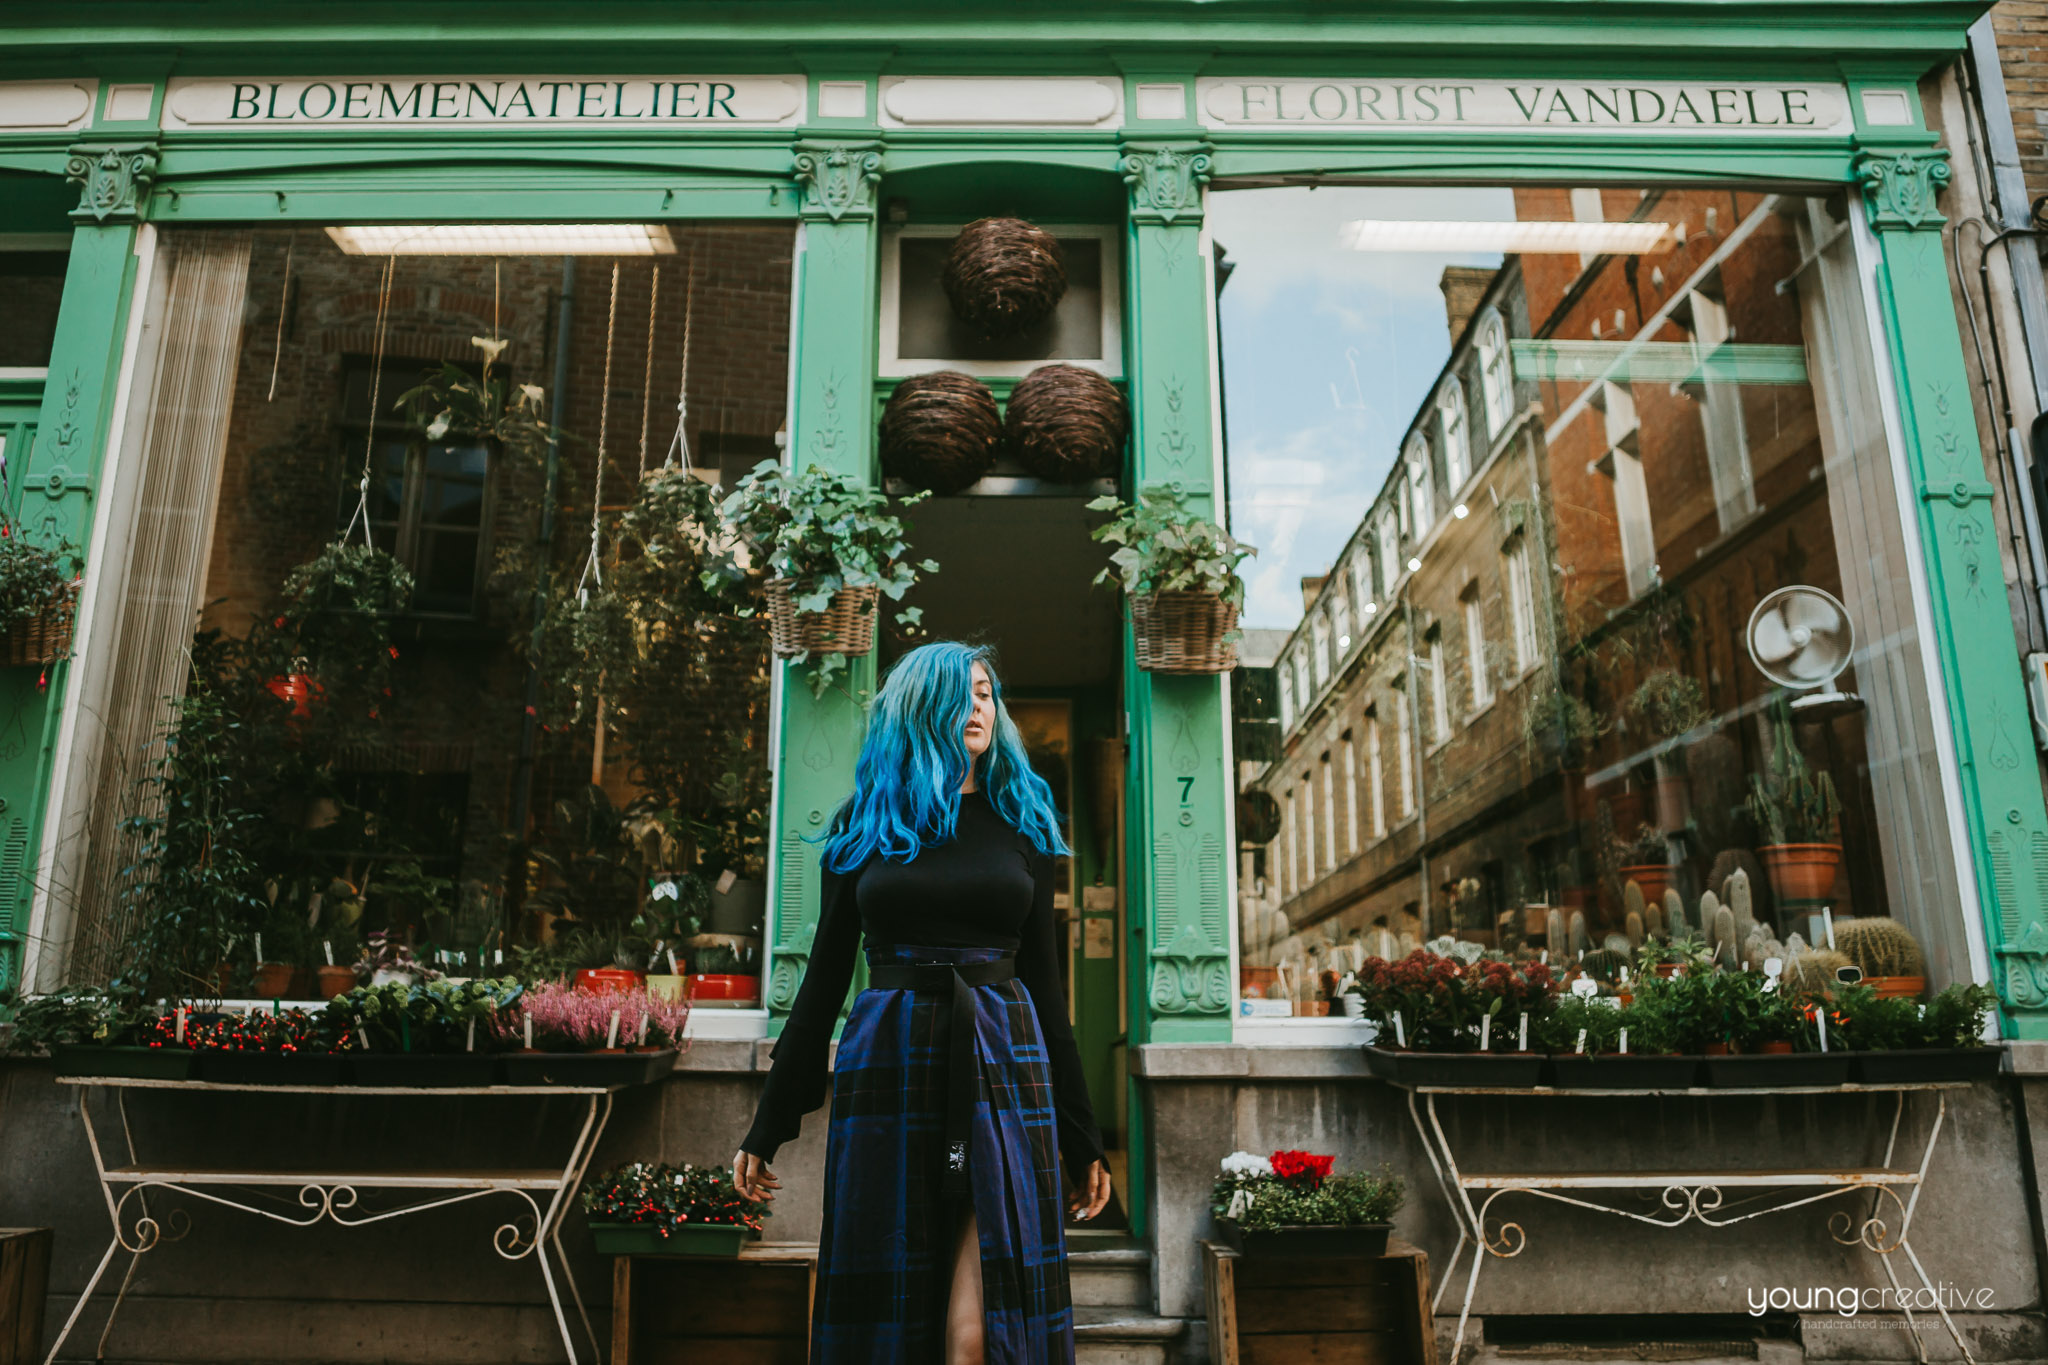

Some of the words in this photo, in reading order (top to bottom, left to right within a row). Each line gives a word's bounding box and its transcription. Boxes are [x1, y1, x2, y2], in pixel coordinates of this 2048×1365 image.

[228, 82, 739, 119] BLOEMENATELIER
[1240, 85, 1475, 121] FLORIST
[1505, 86, 1816, 125] VANDAELE
[1177, 777, 1195, 803] 7
